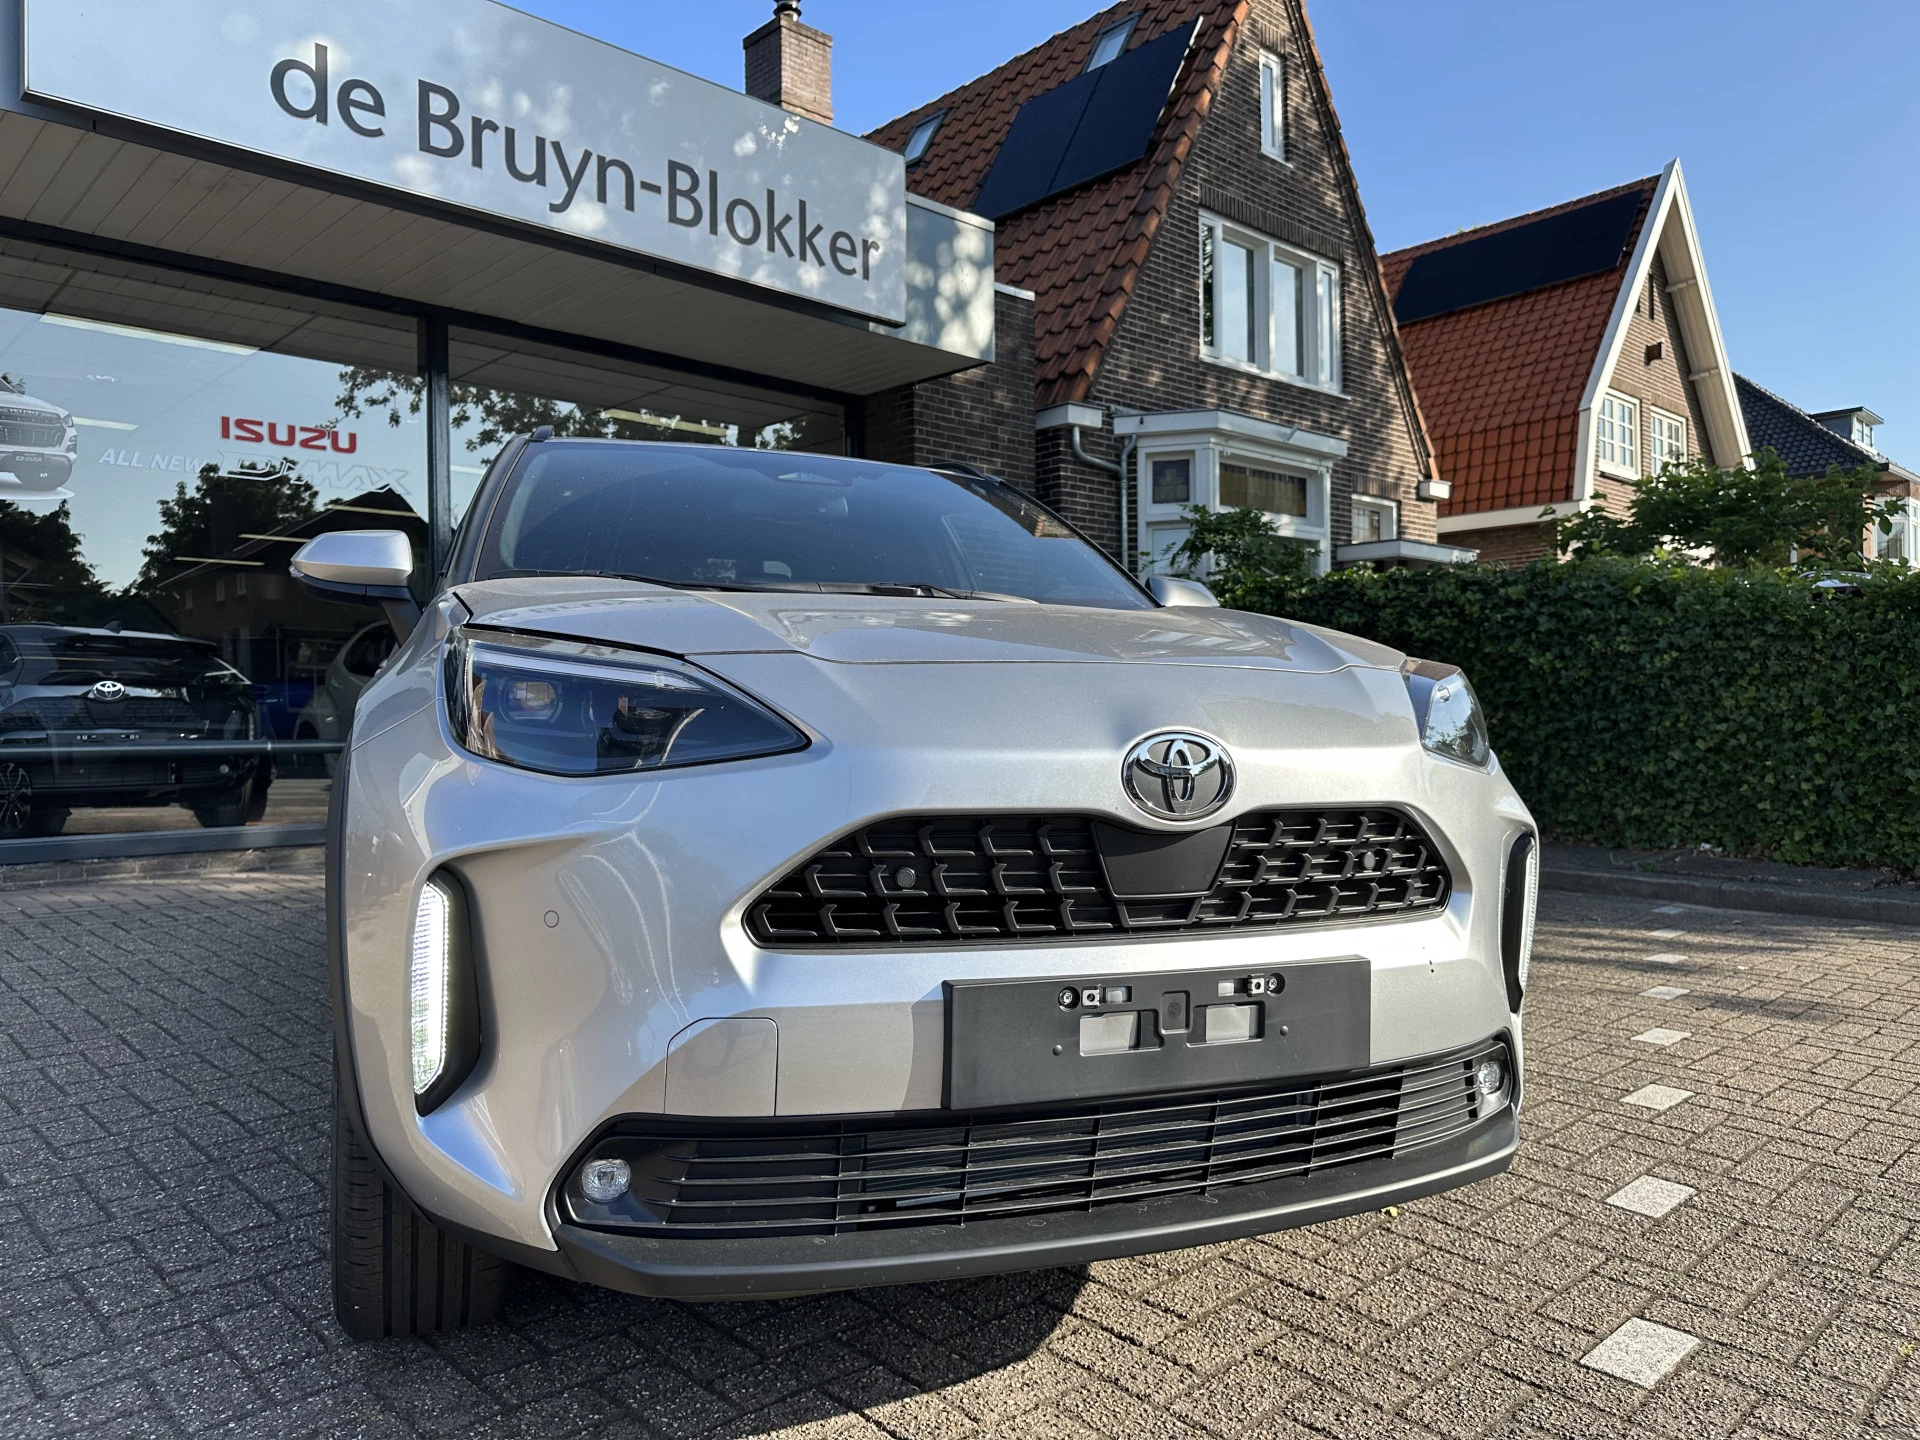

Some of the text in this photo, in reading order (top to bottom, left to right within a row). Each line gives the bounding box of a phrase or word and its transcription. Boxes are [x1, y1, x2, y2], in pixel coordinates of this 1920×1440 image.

[270, 42, 880, 281] de Bruyn-Blokker
[221, 416, 357, 454] ISUZU
[98, 449, 143, 467] ALL
[151, 454, 206, 473] NEW
